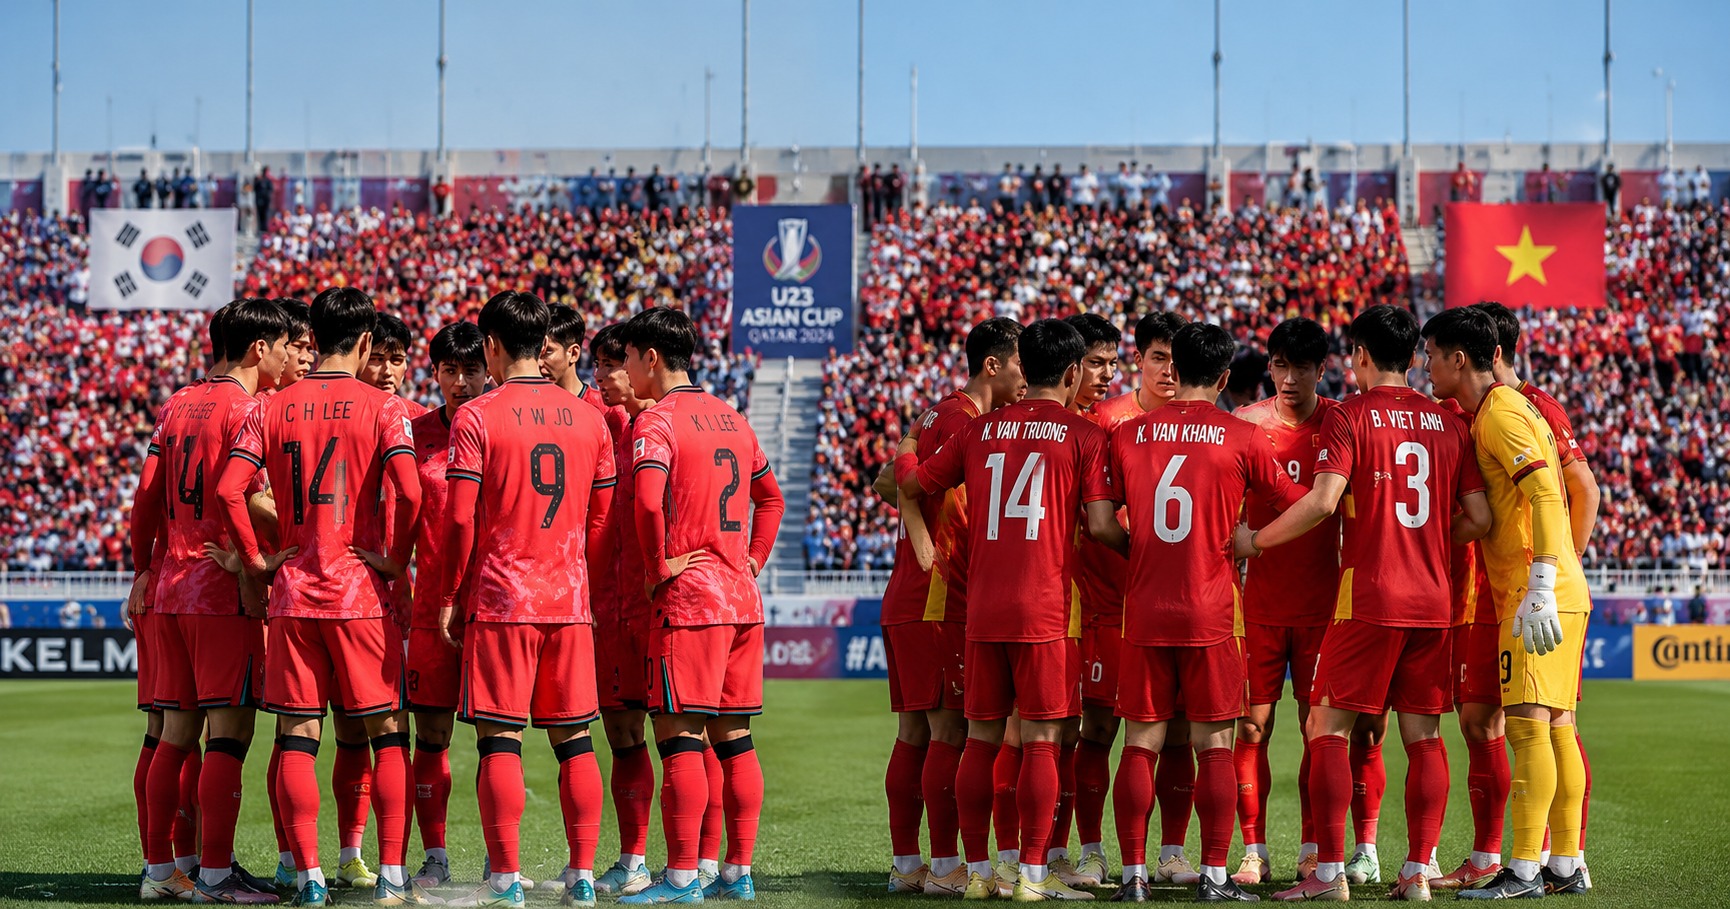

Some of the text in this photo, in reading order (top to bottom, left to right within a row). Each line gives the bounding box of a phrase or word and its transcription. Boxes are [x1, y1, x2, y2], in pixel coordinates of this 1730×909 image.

[771, 286, 815, 306] U23
[740, 307, 844, 327] ASIAN CUP
[748, 328, 835, 344] QATAR 2024
[286, 401, 354, 422] C H LEE
[512, 407, 573, 426] Y W JO
[690, 414, 704, 431] K
[713, 414, 738, 431] LEE
[1370, 408, 1445, 432] B. VIET ANH
[996, 421, 1020, 440] VAN
[1023, 421, 1068, 443] TRUONG
[1135, 422, 1226, 446] K. VAN KHANG
[283, 436, 348, 525] 14
[1287, 459, 1301, 484] 9
[530, 443, 565, 529] 9
[713, 448, 741, 532] 2
[984, 452, 1046, 540] 14
[1395, 441, 1431, 529] 3
[1153, 454, 1194, 544] 6
[0, 637, 138, 672] KELM
